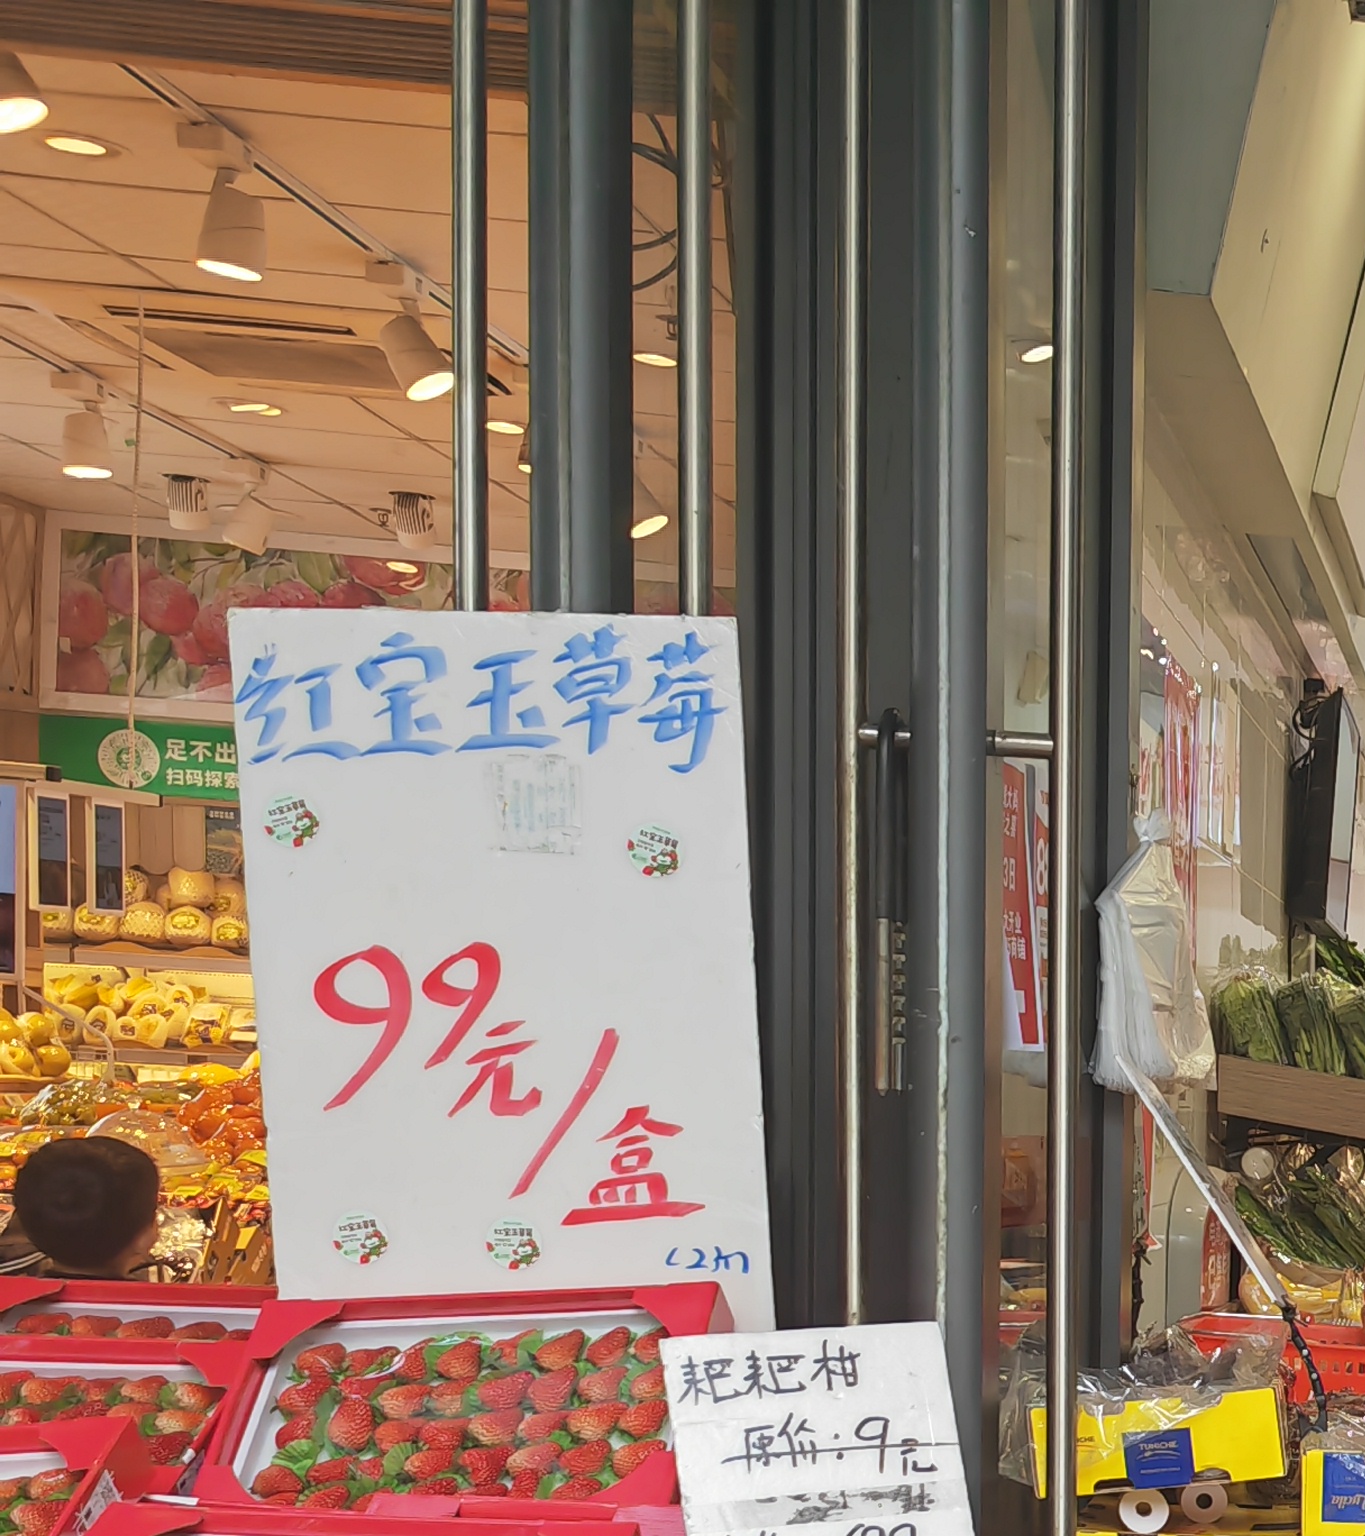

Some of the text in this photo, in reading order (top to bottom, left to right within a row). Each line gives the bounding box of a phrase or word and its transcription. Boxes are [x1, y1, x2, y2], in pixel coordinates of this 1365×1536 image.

[234, 622, 728, 775] 红宝玉草莓
[313, 941, 707, 1226] 99元/盒
